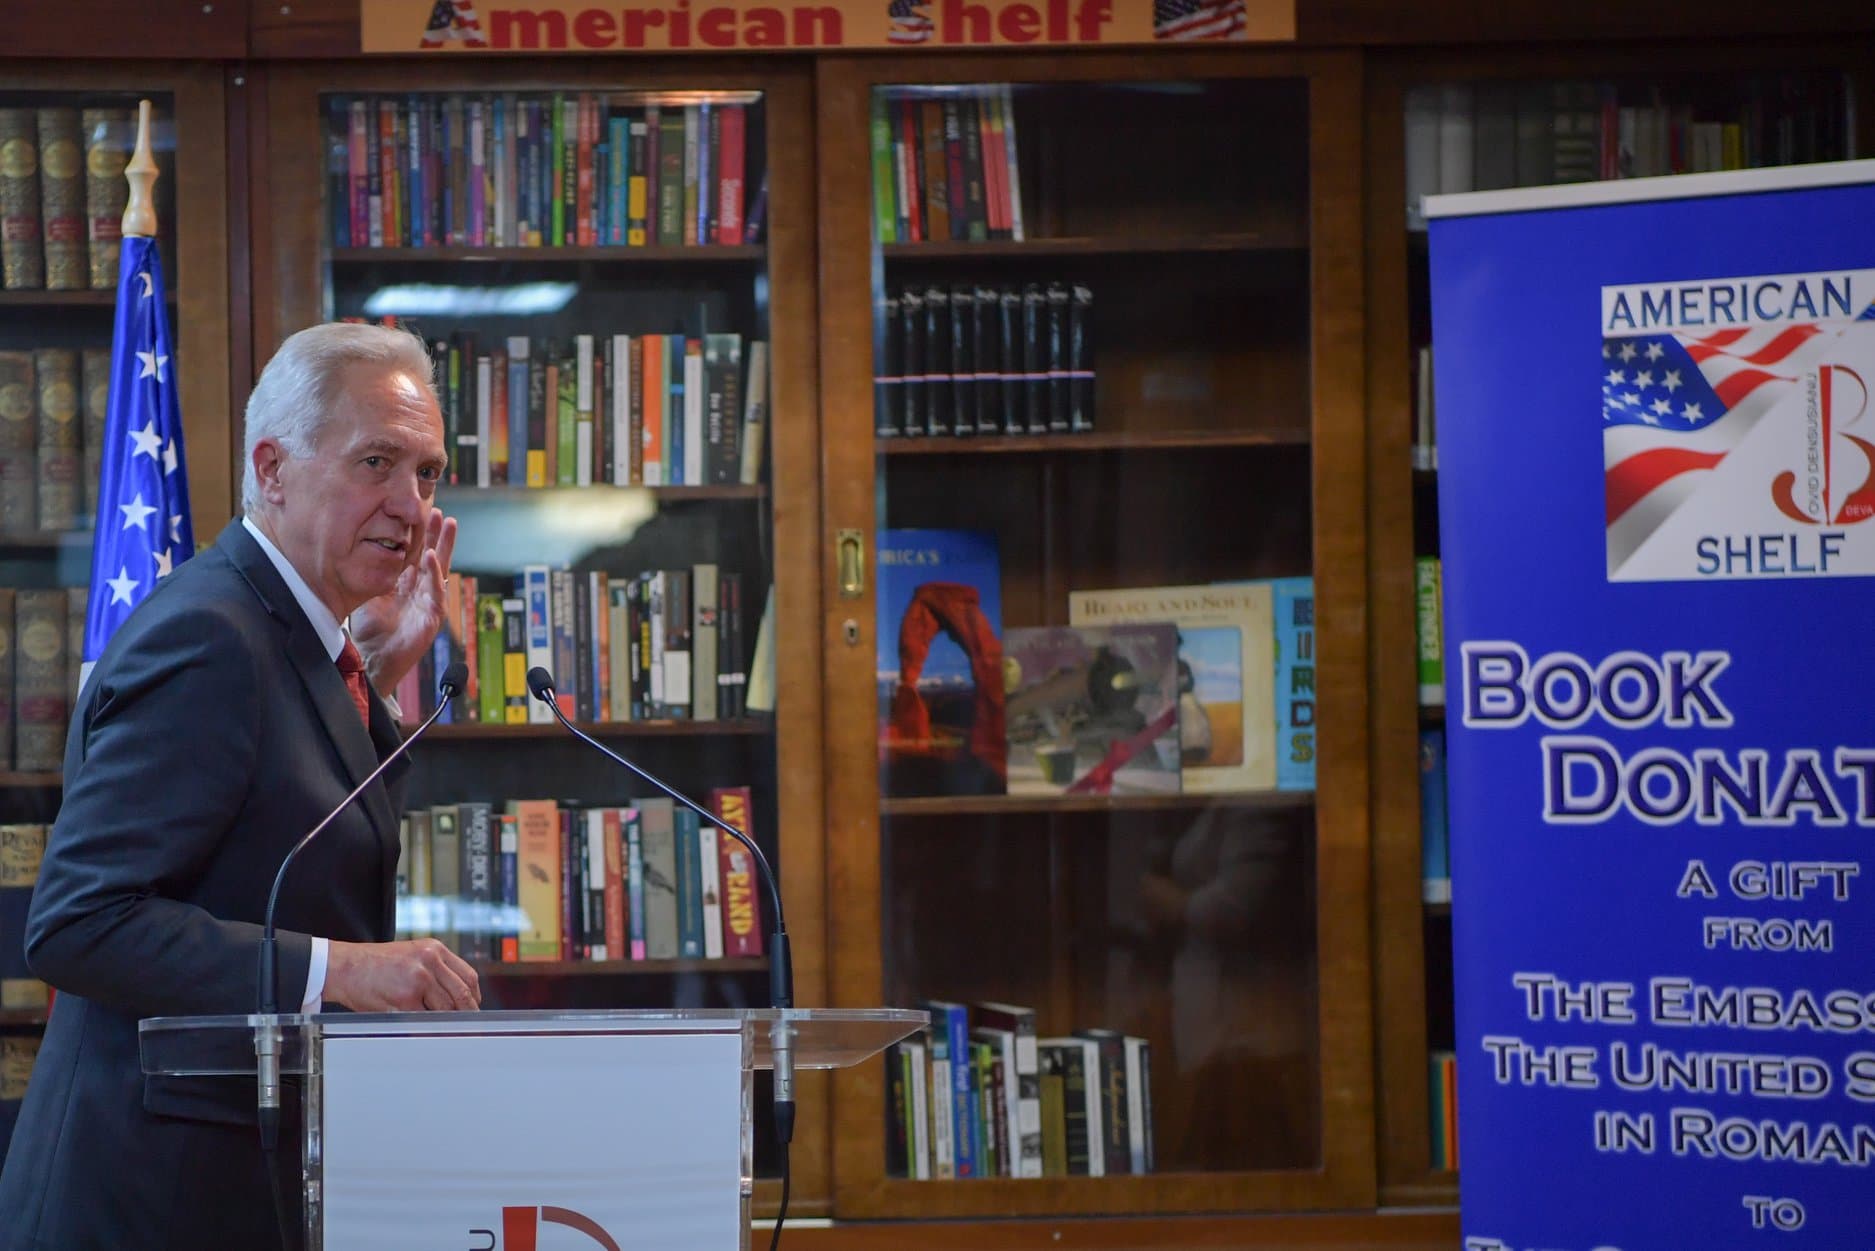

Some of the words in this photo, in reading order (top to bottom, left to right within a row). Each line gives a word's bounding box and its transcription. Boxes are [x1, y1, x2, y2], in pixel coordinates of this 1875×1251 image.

[419, 0, 843, 48] American
[887, 0, 1114, 44] Shelf
[1608, 276, 1853, 331] AMERICAN
[1696, 531, 1846, 575] SHELF
[1460, 640, 1734, 730] BOOK
[1677, 860, 1718, 898] A
[1730, 860, 1860, 900] GIFT
[1703, 917, 1834, 952] FROM
[1513, 972, 1636, 1025] THE
[1650, 976, 1875, 1033] EMBAS
[1482, 1035, 1598, 1089] THE
[1611, 1042, 1832, 1098] UNITED
[1594, 1110, 1655, 1154] IN
[1742, 1195, 1806, 1231] TO
